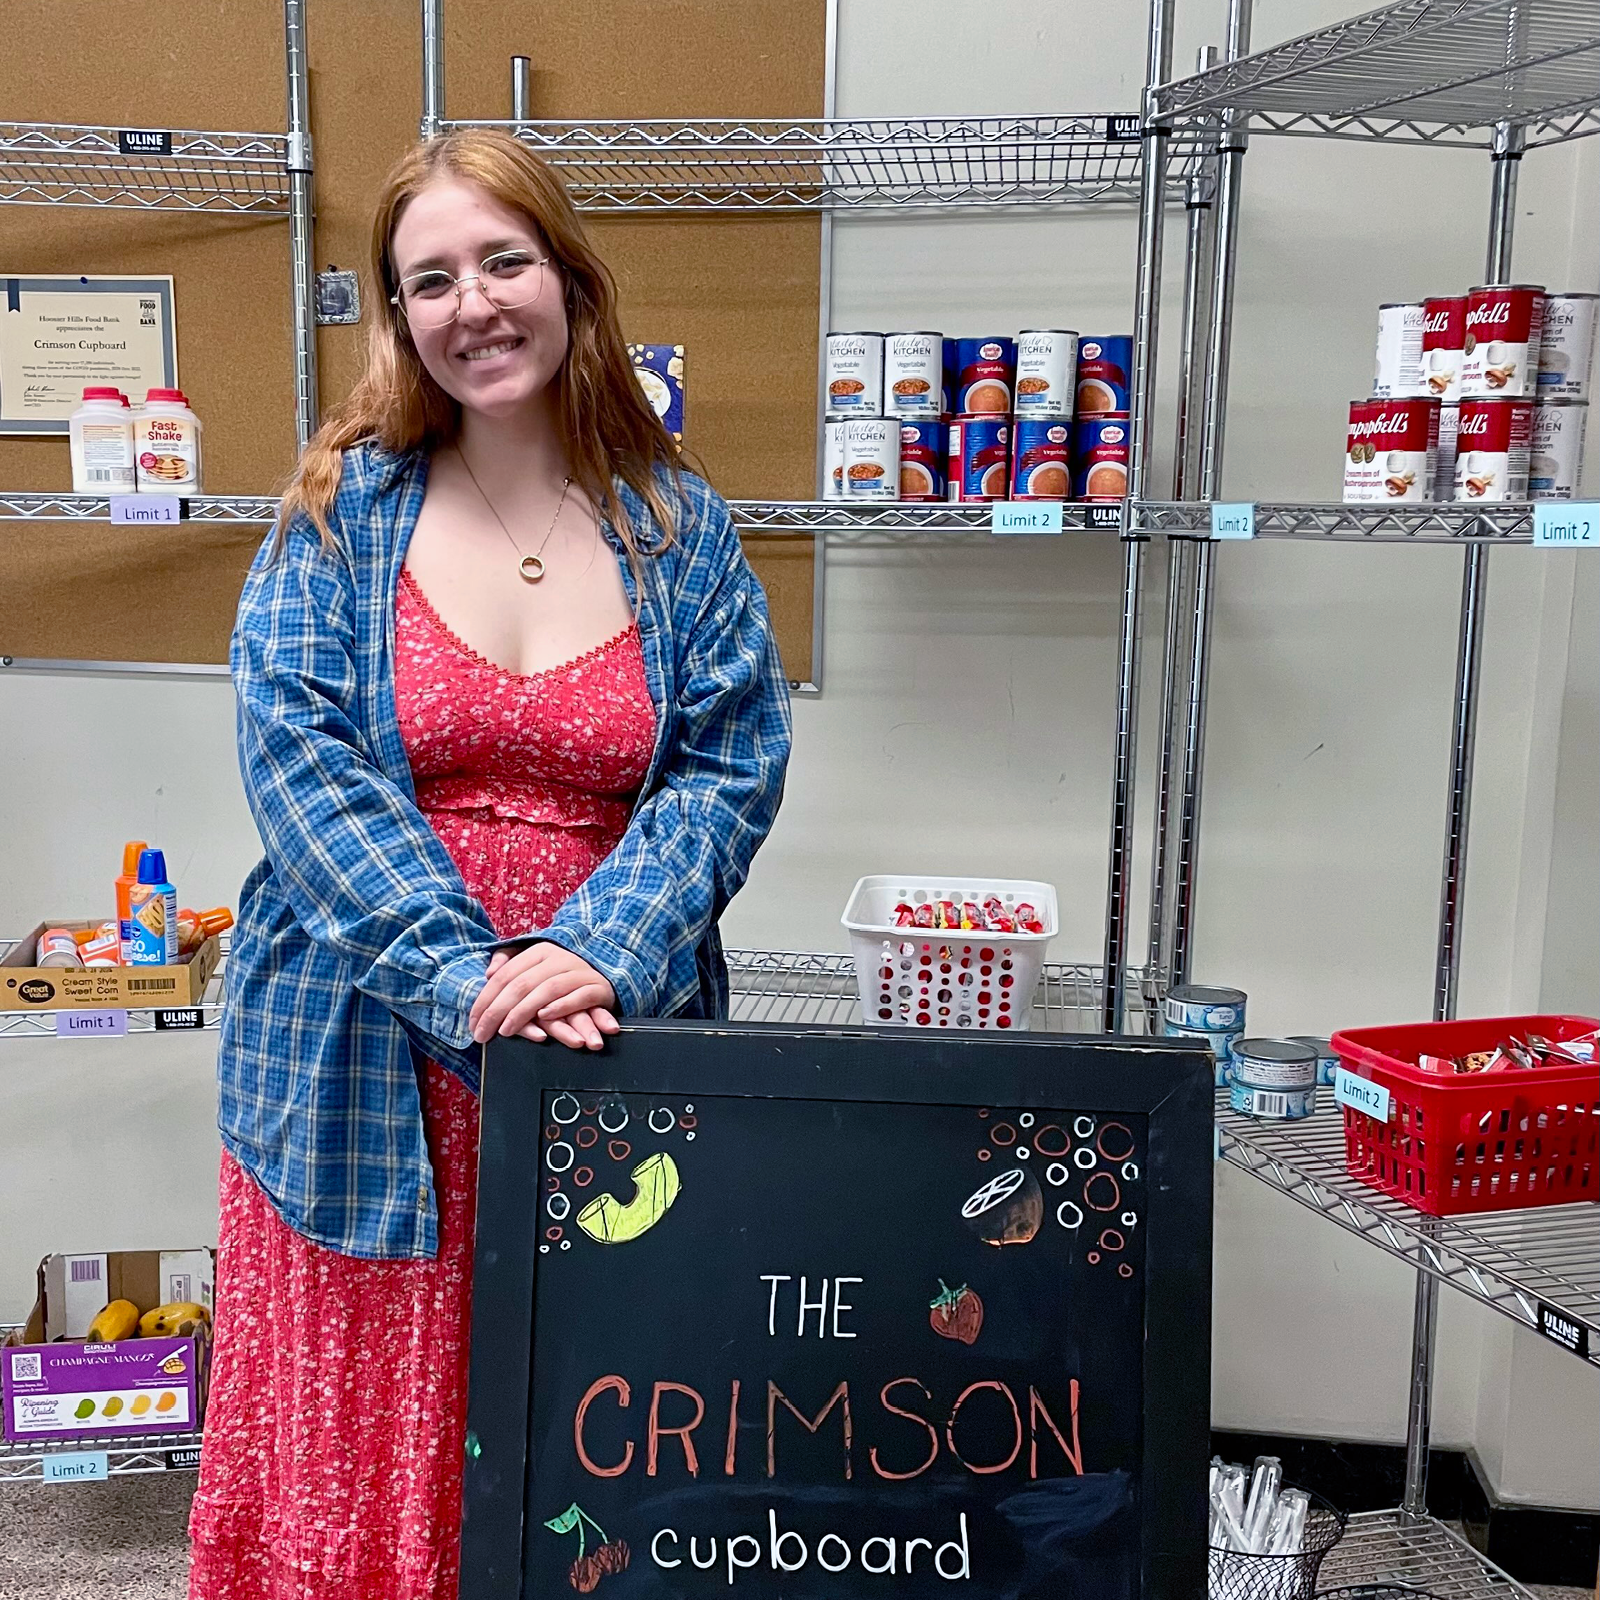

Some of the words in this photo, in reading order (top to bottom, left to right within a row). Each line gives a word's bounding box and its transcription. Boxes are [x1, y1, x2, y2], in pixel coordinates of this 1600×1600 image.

[1115, 119, 1139, 131] ULI
[126, 133, 163, 145] ULINE
[1466, 302, 1511, 330] pbell's
[1423, 312, 1450, 333] bell's
[34, 340, 76, 350] Crimson
[78, 340, 126, 352] Cupboard
[830, 348, 865, 356] KITCHEN
[894, 347, 931, 356] KITCHEN
[897, 361, 926, 369] Vegetable
[152, 421, 177, 431] Fast
[1366, 413, 1409, 438] pbell's
[1458, 413, 1488, 435] bell's
[148, 431, 182, 441] Shake
[848, 433, 886, 441] KITCHEN
[125, 508, 159, 520] Limit
[165, 508, 172, 520] 1
[1093, 509, 1120, 521] ULIN
[1002, 514, 1037, 527] Limit
[1042, 514, 1050, 526] 2
[1218, 516, 1240, 531] Limit
[1243, 517, 1248, 532] 2
[1543, 522, 1577, 540] Limit
[1582, 521, 1590, 540] 2
[62, 978, 93, 986] Cream
[97, 977, 118, 986] Style
[22, 985, 48, 994] Great
[29, 990, 49, 999] Value
[65, 987, 92, 995] Sweet
[97, 986, 118, 994] Corn
[163, 1011, 197, 1022] ULINE
[69, 1017, 103, 1030] Limit
[109, 1016, 115, 1027] 1
[1343, 1078, 1371, 1104] Limit
[1373, 1093, 1380, 1108] 2
[760, 1275, 864, 1339] THE
[1544, 1311, 1580, 1344] ULINE
[50, 1356, 112, 1367] CHAMPAGNE
[21, 1398, 58, 1407] Ripening
[31, 1407, 55, 1417] Guide
[574, 1375, 1085, 1481] CRIMSON
[52, 1462, 85, 1477] Limit
[89, 1462, 98, 1474] 2
[651, 1509, 971, 1585] cupboard
